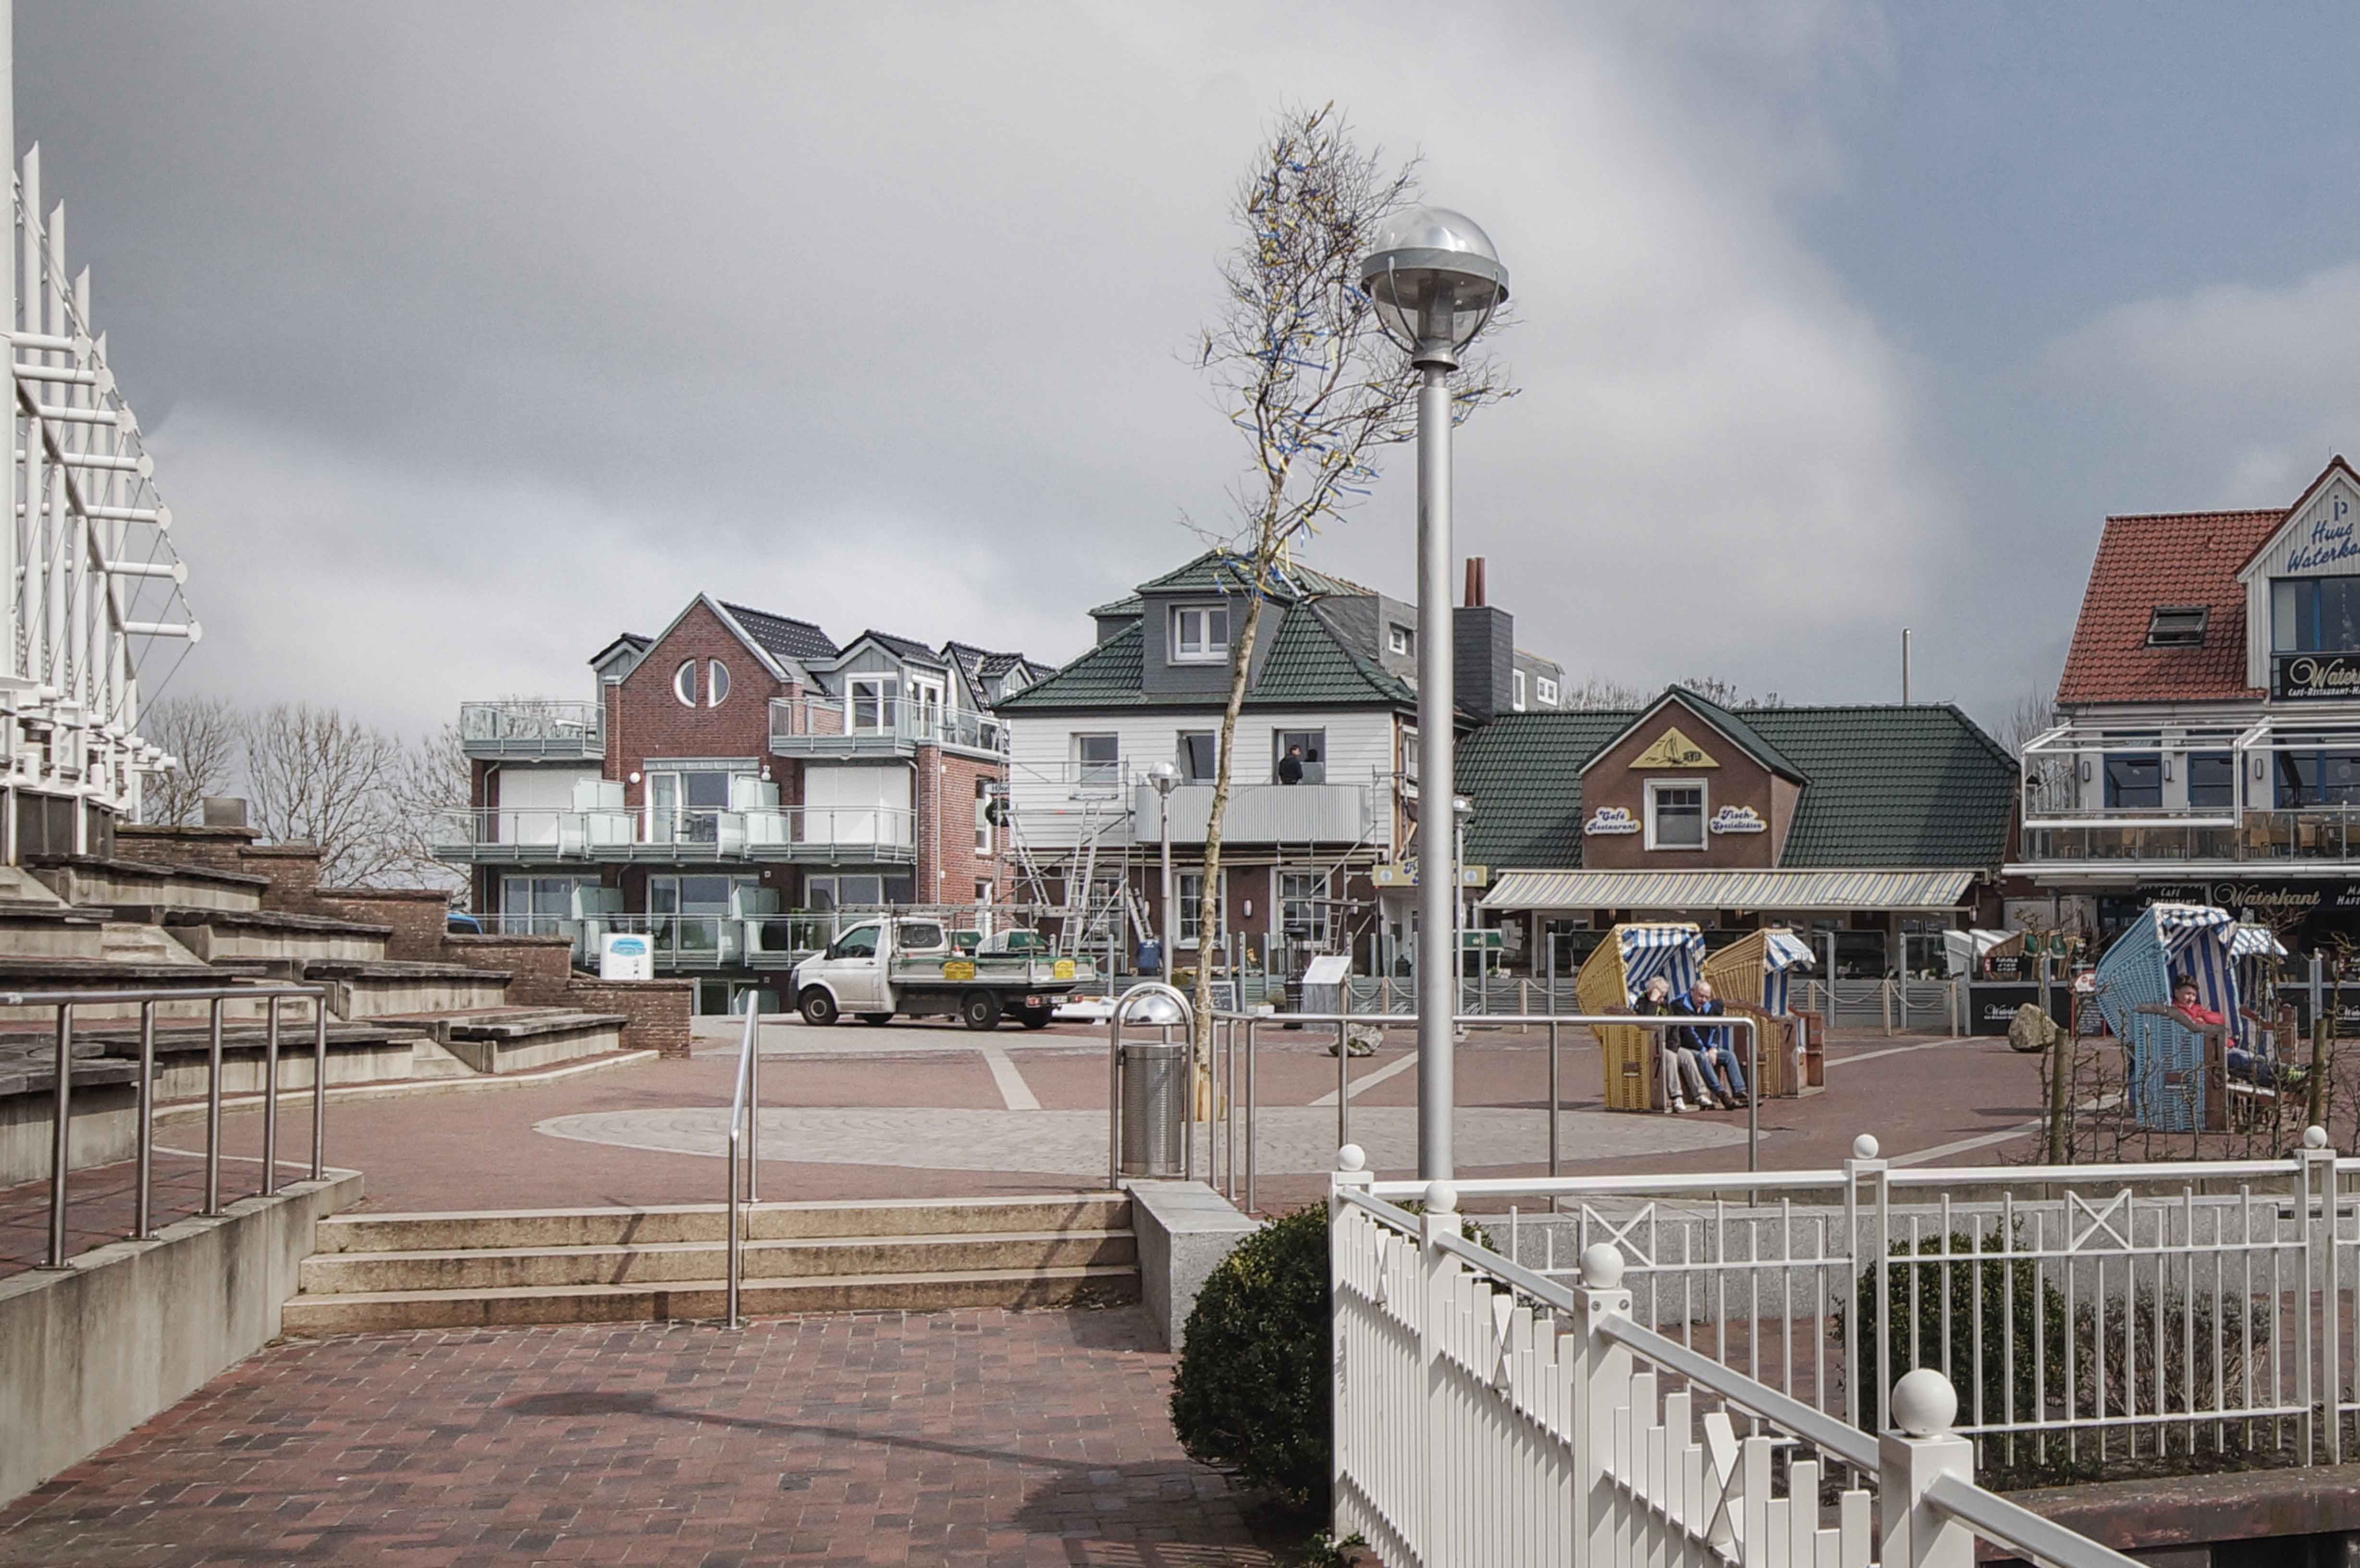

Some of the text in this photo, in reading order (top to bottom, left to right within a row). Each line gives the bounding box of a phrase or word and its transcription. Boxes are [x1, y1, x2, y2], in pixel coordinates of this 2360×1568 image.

[2311, 520, 2353, 545] Huus
[2287, 536, 2360, 573] Waterka
[2289, 657, 2360, 688] Water
[1587, 821, 1636, 832] Restaurant
[1599, 810, 1625, 821] Café
[2214, 883, 2321, 907] Waterkant
[1784, 1024, 1793, 1042] 7
